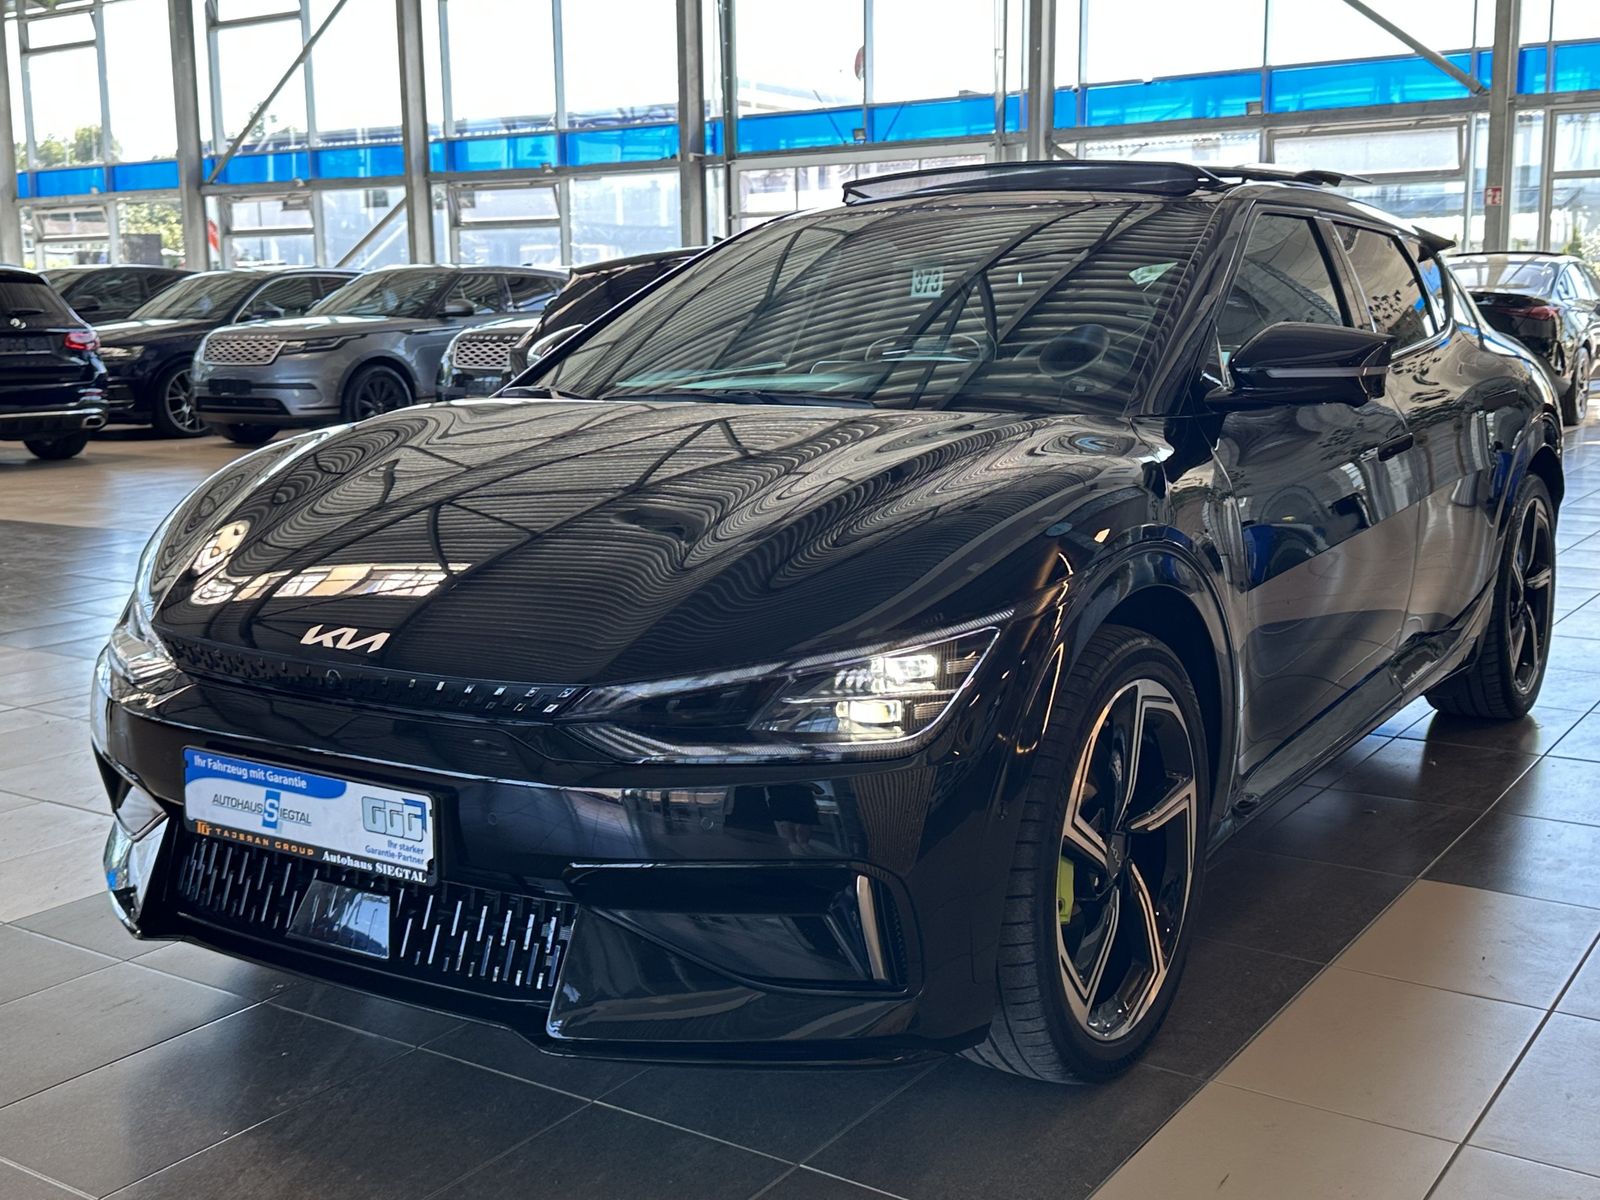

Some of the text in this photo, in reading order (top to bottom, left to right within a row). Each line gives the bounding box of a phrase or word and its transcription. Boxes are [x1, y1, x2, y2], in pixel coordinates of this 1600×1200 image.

[300, 624, 390, 653] KIA
[194, 755, 307, 789] Ihr Fahrzeug mit Garantie
[212, 793, 312, 824] AUTOHAUS SIEGTAL
[274, 841, 314, 856] GROUP
[365, 844, 425, 865] Garantie-Partner
[387, 840, 425, 855] Ihr starker
[322, 850, 427, 883] Autohaus SIEGTAL
